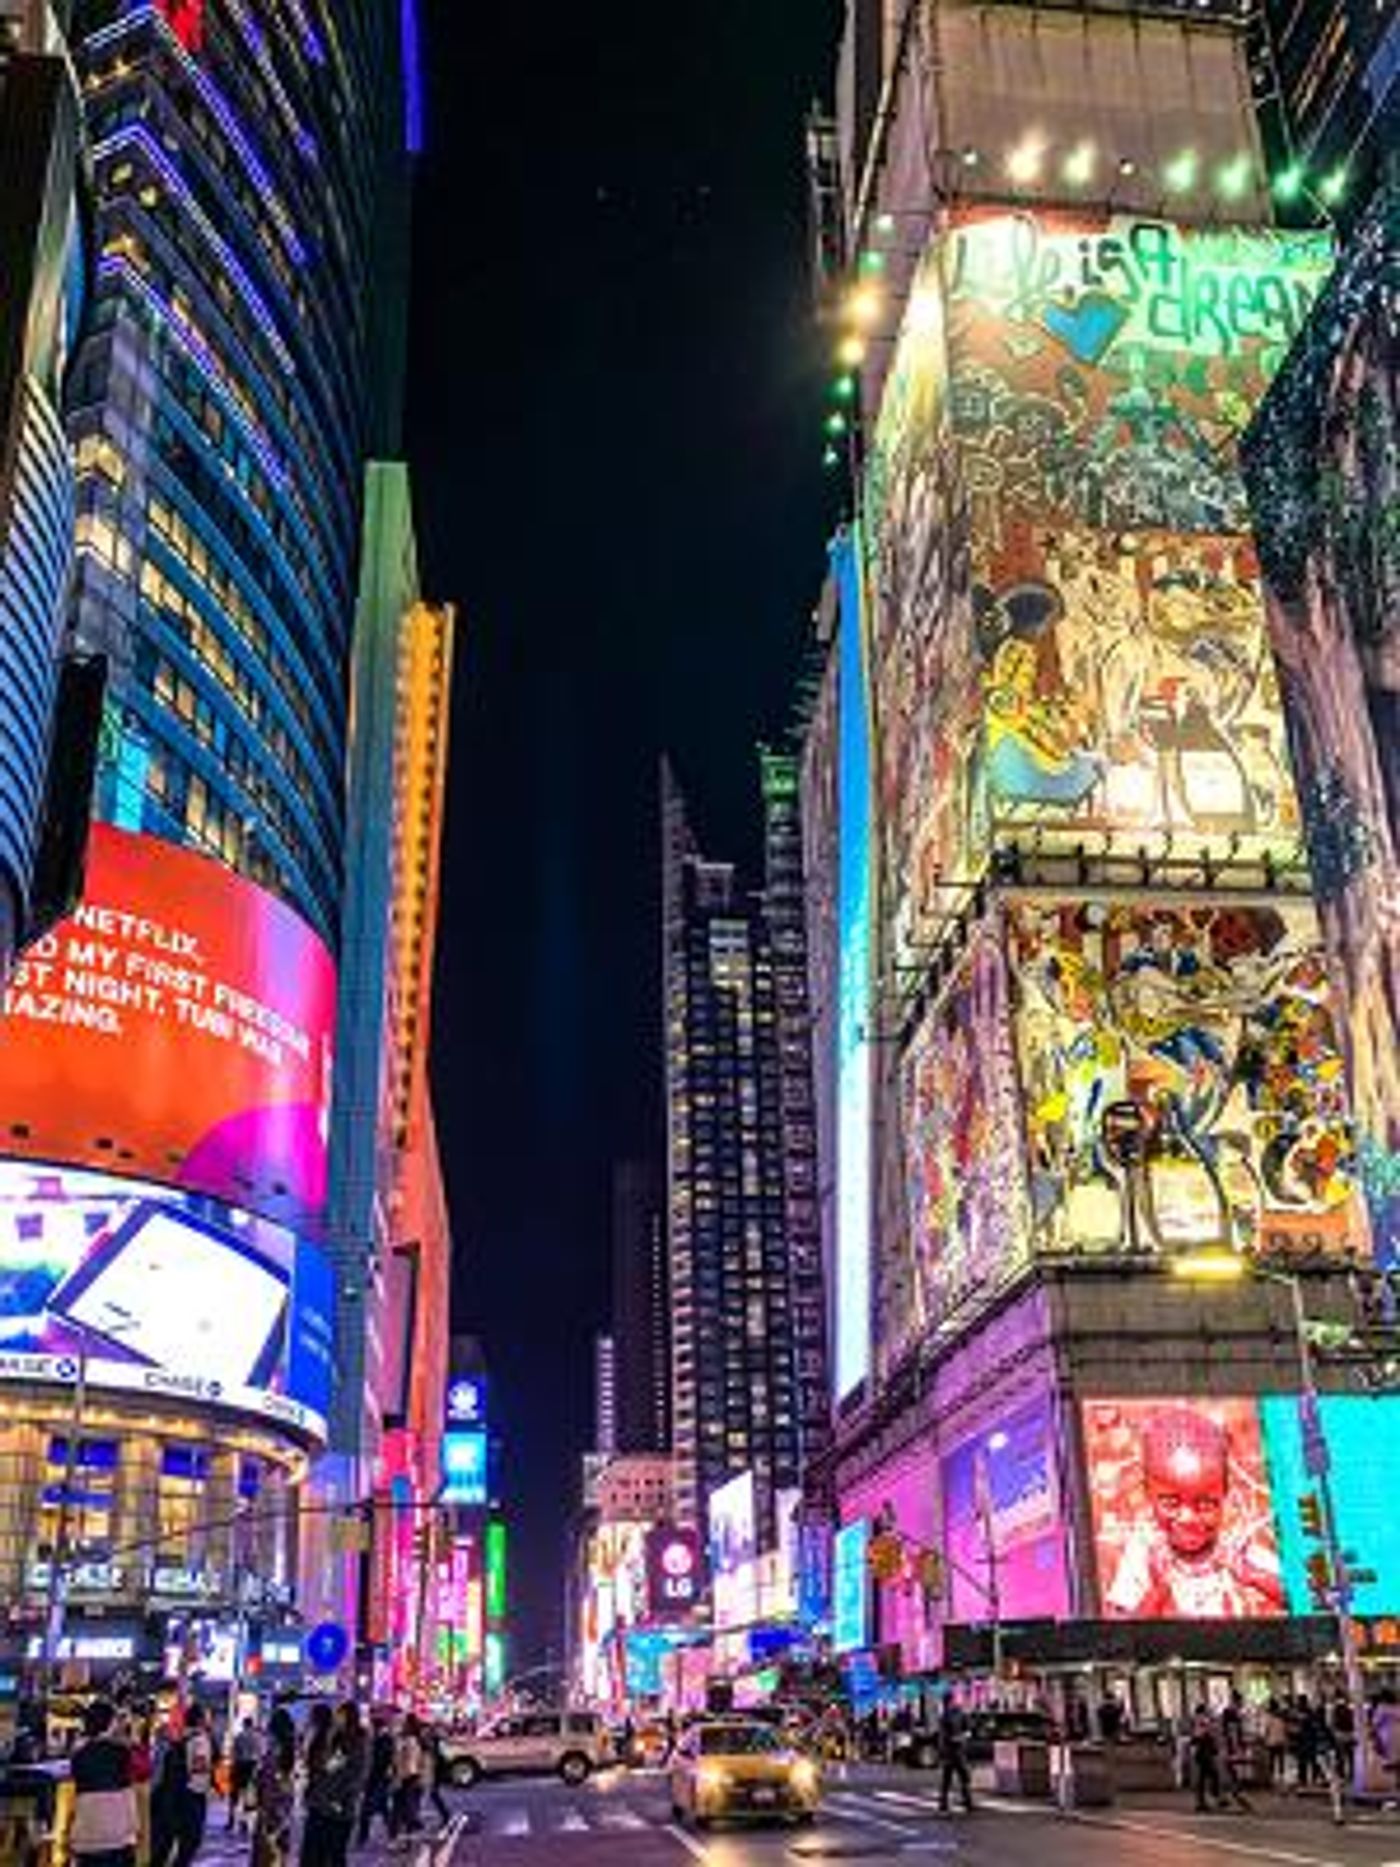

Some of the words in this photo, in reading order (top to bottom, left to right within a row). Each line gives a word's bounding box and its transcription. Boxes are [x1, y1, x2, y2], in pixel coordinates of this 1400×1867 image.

[1078, 238, 1141, 303] is
[1129, 223, 1177, 286] A
[69, 938, 119, 972] MY
[126, 952, 208, 998] FIRST
[664, 1577, 693, 1597] LG
